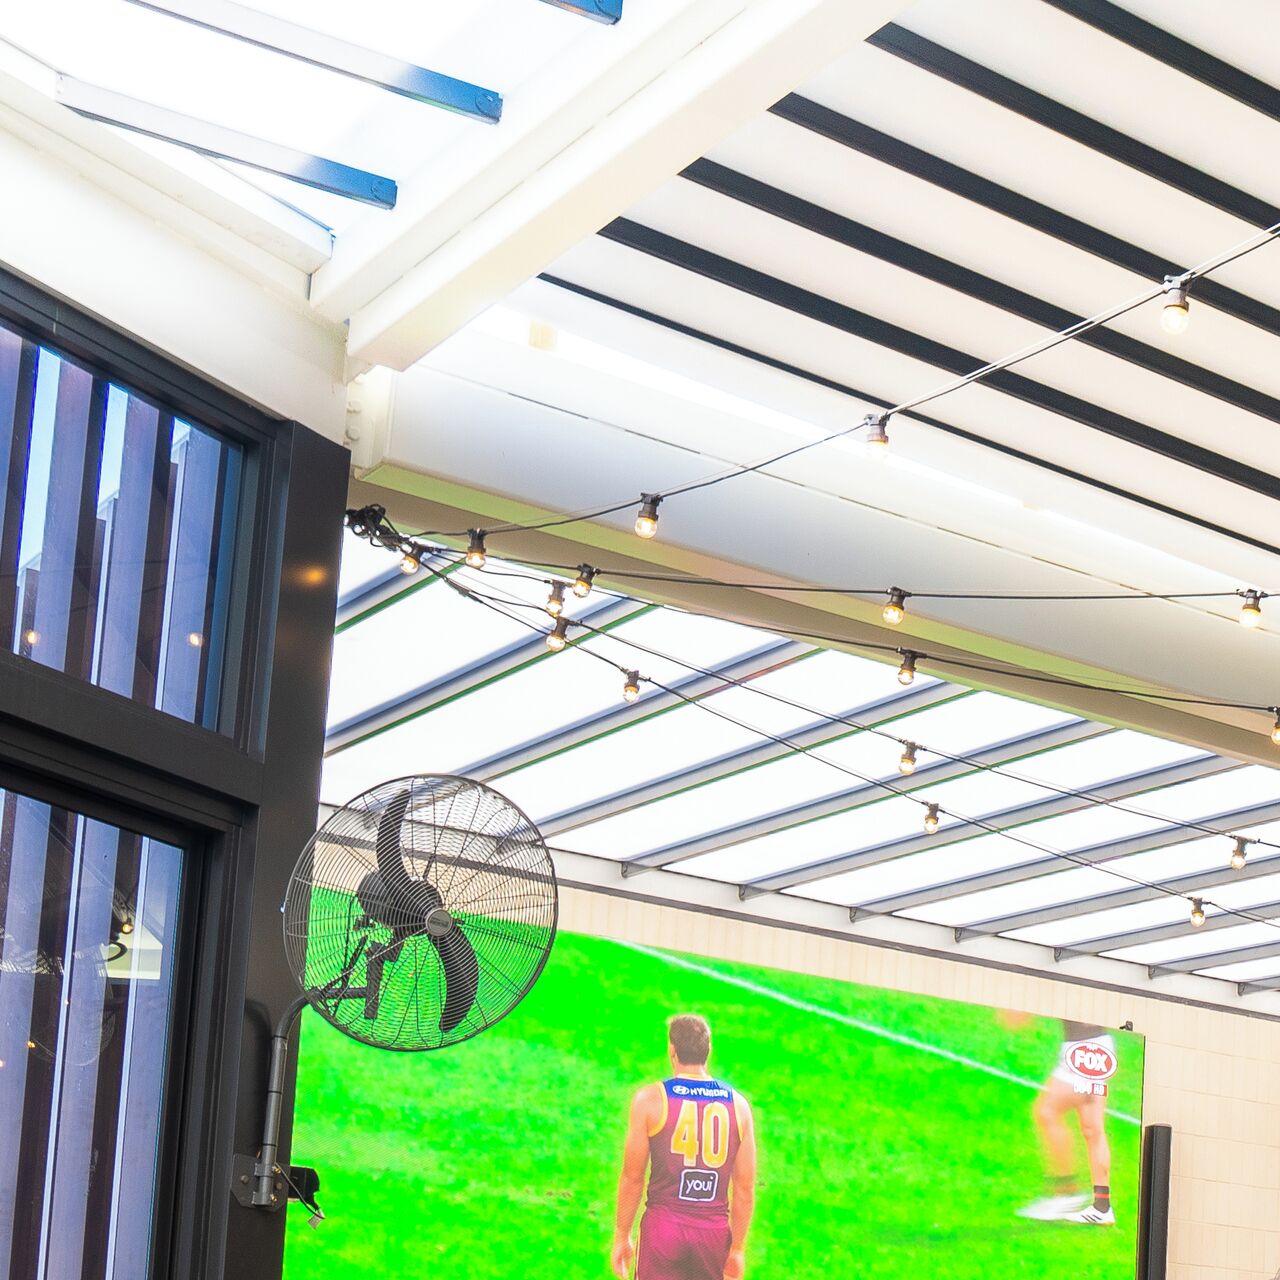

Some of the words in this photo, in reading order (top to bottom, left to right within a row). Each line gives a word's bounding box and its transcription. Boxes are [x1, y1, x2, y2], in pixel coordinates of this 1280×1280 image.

[1074, 1049, 1108, 1073] FOX
[671, 1099, 730, 1168] 40
[686, 1176, 713, 1194] youi
